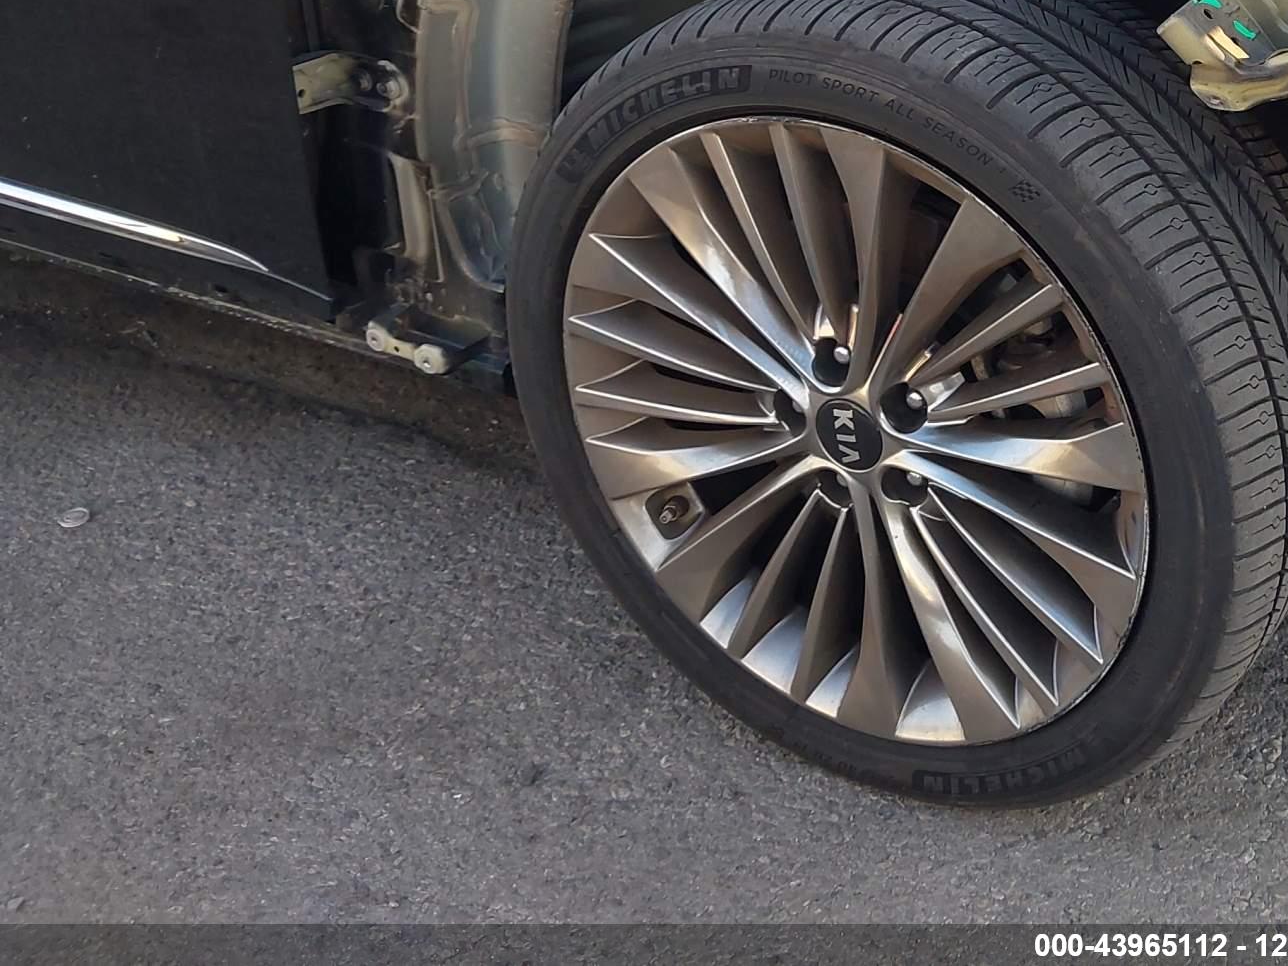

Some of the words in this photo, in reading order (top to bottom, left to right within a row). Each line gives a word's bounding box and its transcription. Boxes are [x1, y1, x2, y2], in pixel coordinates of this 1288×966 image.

[586, 67, 741, 151] MICHELIN
[768, 68, 817, 84] PILOT
[821, 76, 880, 103] SPORT
[883, 98, 914, 119] ALL
[922, 115, 994, 167] SEASON
[832, 408, 861, 464] KIA
